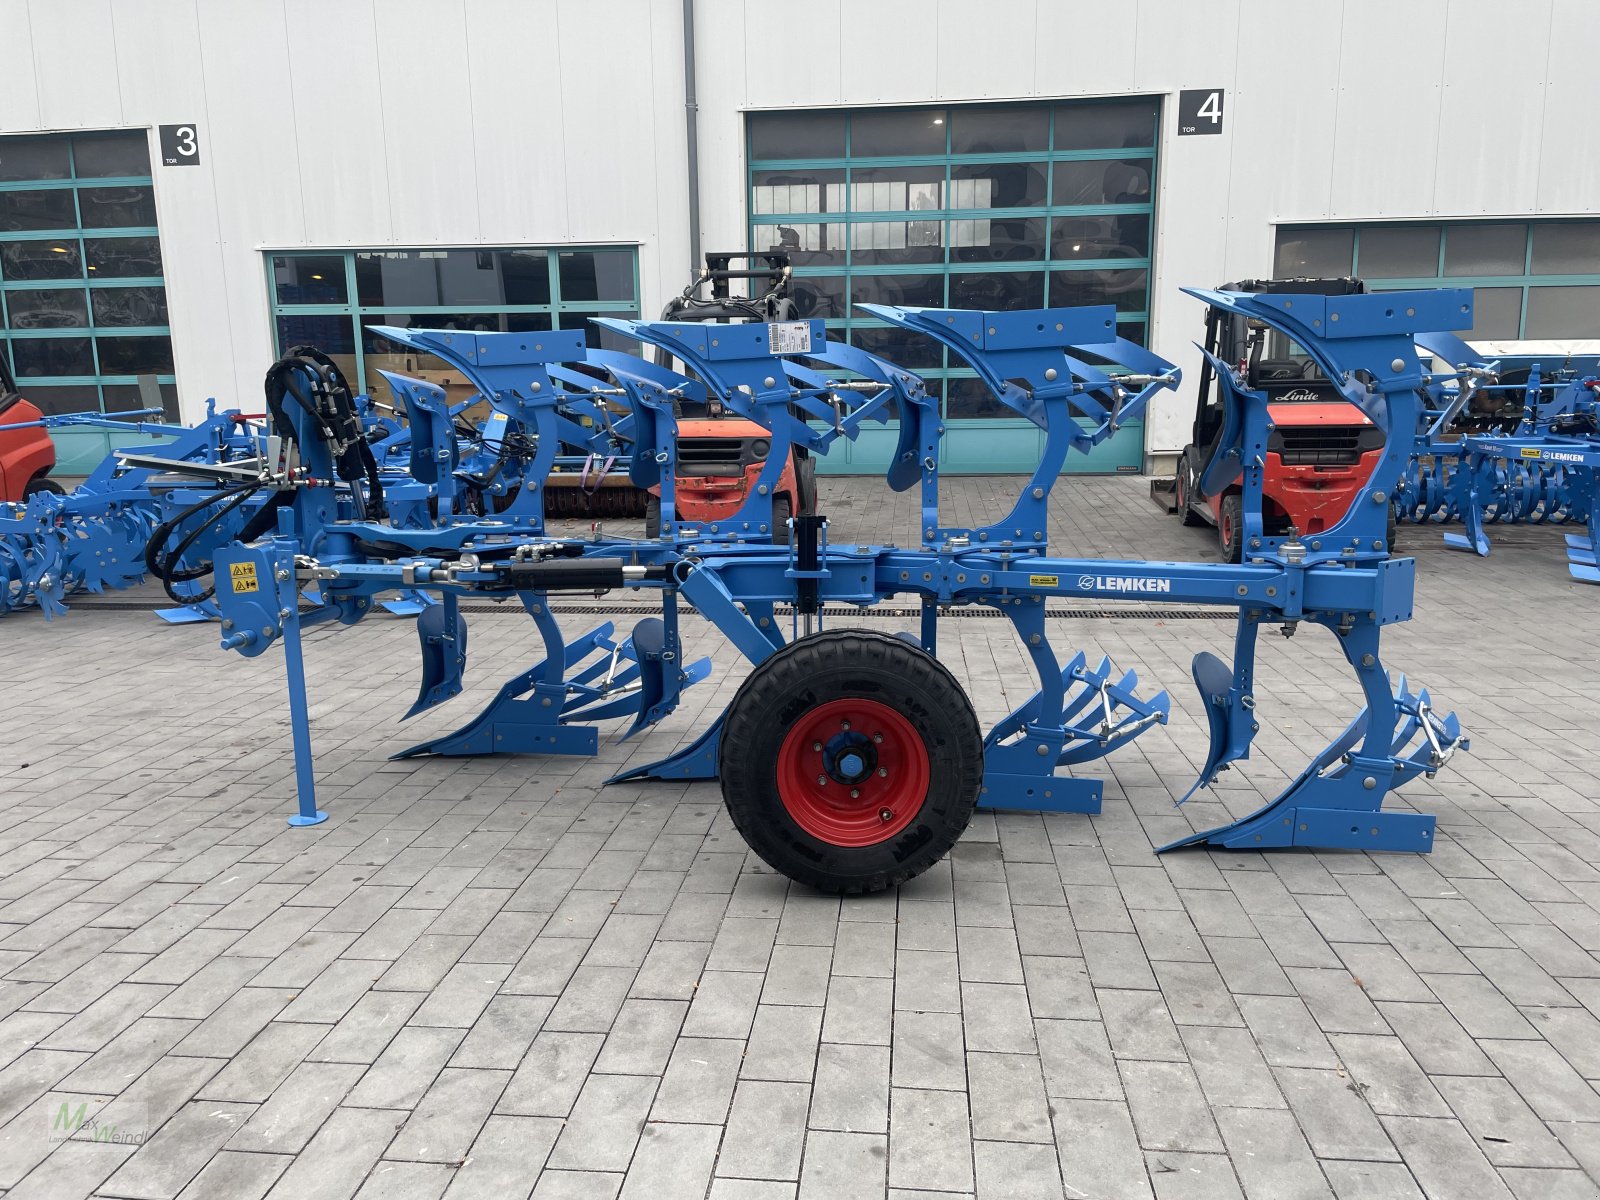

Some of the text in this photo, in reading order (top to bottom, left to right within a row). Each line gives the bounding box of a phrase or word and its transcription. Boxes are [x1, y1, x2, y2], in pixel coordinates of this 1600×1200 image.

[1197, 92, 1221, 123] 4
[176, 127, 196, 156] 3
[1275, 388, 1319, 401] Linde
[1550, 452, 1585, 463] LEMKEN
[1096, 576, 1171, 593] LEMKEN
